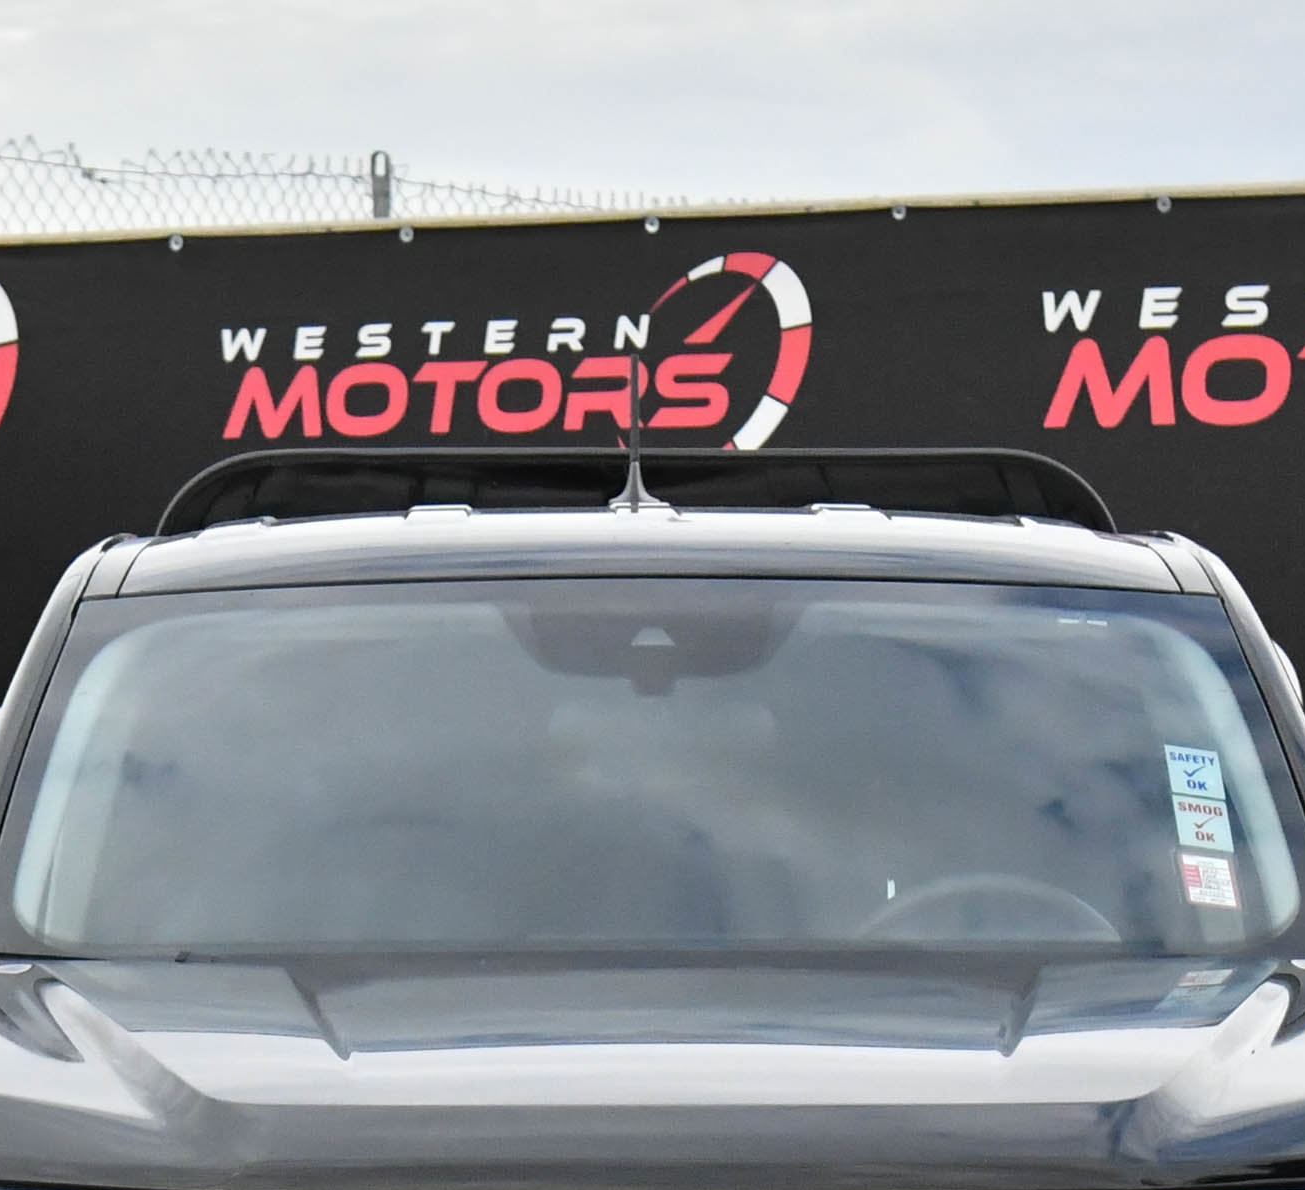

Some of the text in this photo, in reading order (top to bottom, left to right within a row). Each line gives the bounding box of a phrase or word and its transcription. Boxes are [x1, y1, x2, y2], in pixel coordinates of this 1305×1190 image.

[220, 313, 651, 363] WESTERN
[221, 352, 734, 440] MOTORS
[1169, 751, 1215, 766] SAFETY
[1186, 779, 1208, 791] OK
[1177, 801, 1224, 817] SMOG
[1195, 831, 1216, 843] OK
